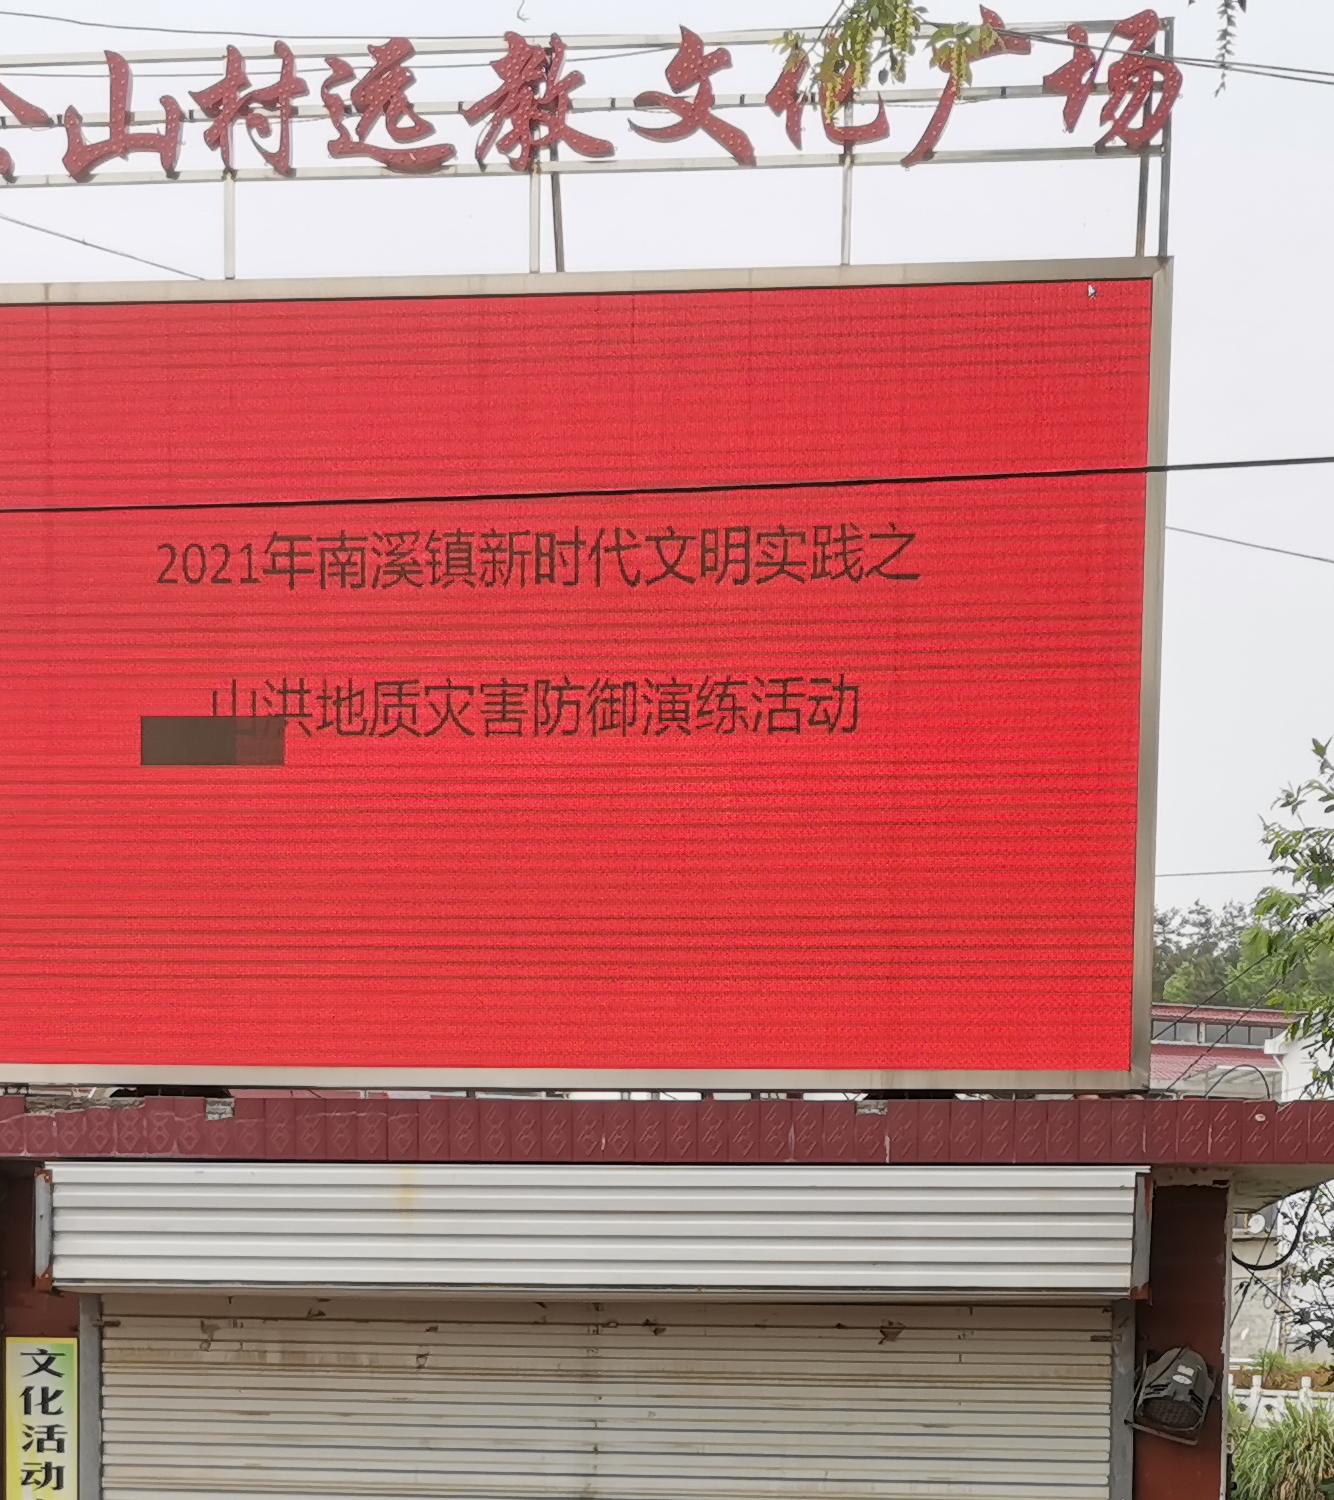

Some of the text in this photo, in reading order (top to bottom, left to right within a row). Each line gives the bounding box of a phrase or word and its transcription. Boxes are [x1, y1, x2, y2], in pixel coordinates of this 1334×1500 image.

[156, 522, 921, 589] 2021年南溪镇新时代文明实践之
[212, 674, 860, 738] 山洪地质灾害防御演练活动
